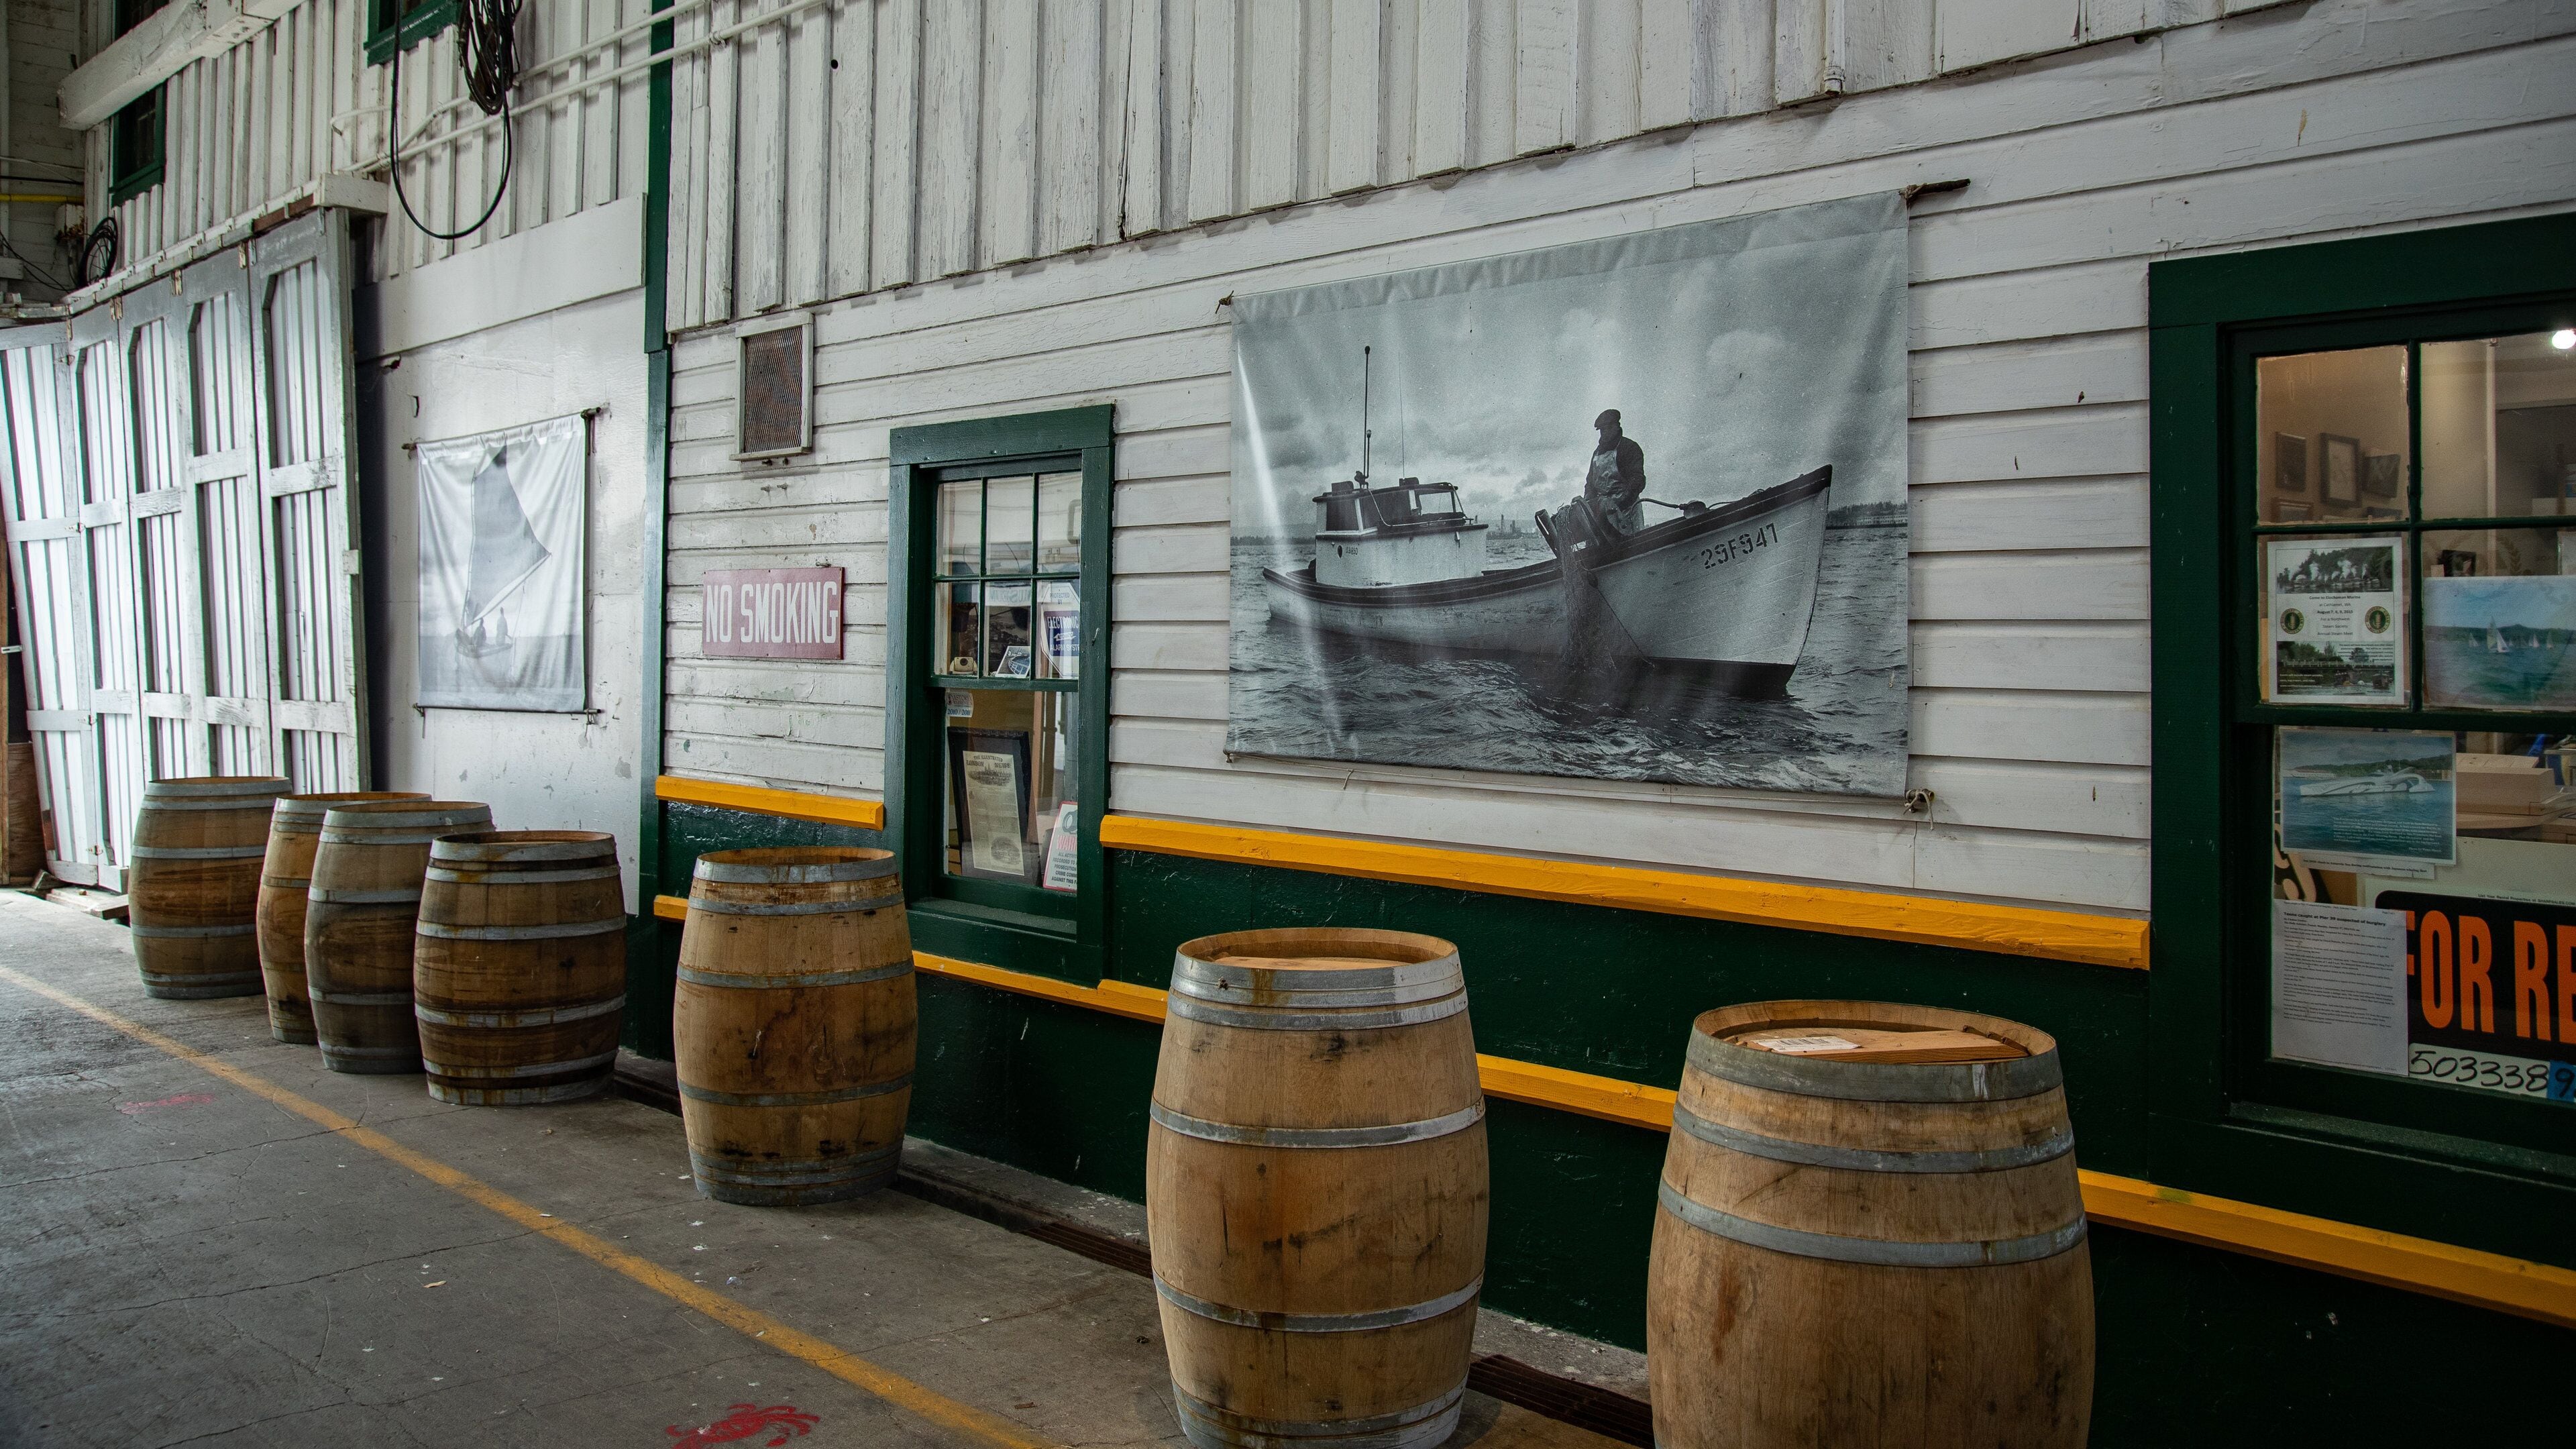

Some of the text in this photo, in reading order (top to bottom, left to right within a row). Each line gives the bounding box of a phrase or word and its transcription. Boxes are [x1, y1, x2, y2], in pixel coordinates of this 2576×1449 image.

[1701, 523, 1778, 569] 29F947
[706, 581, 838, 643] NO SMOKING
[1047, 616, 1079, 629] ELECTRONIC
